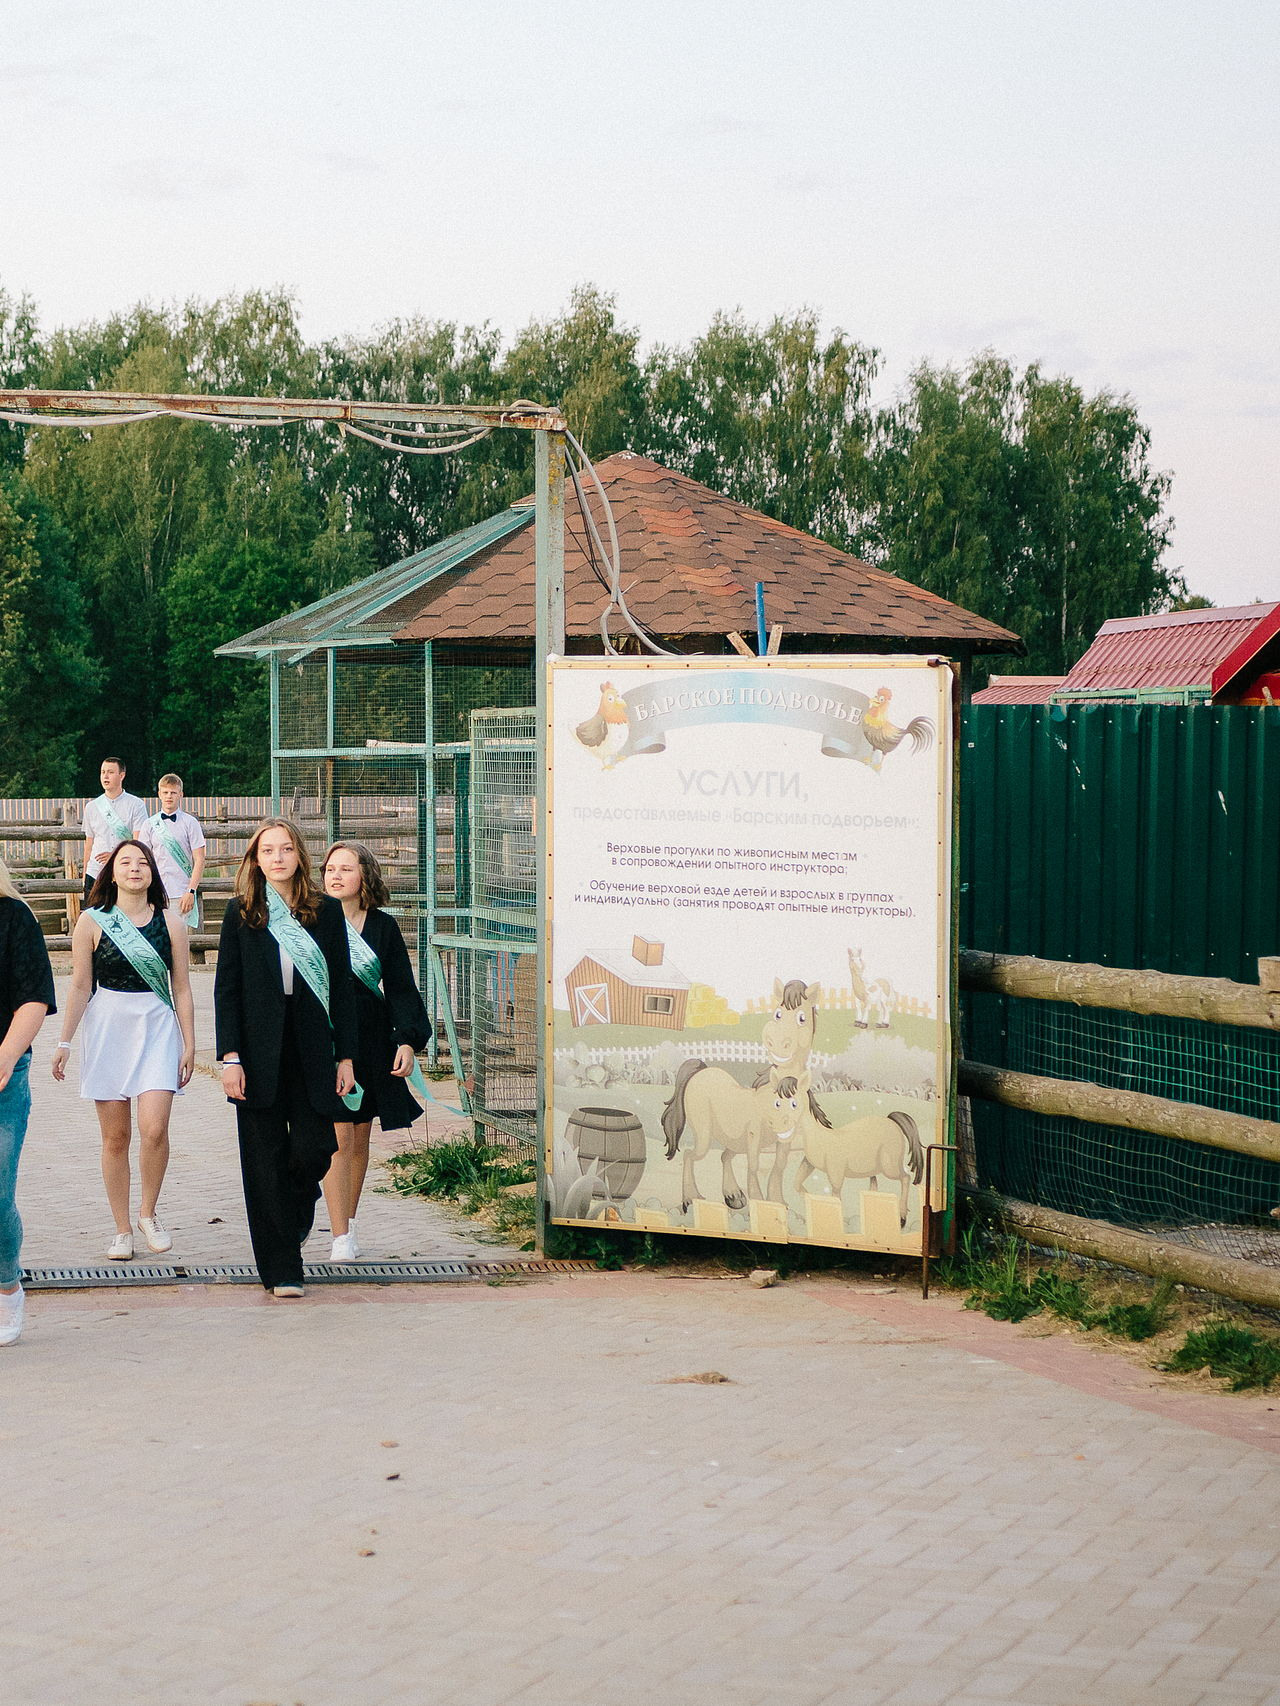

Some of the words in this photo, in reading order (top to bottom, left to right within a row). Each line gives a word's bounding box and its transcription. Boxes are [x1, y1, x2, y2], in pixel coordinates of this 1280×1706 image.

[633, 688, 738, 722] БАРСКОЕ
[739, 687, 863, 726] ПОДВОРЬЕ
[677, 769, 809, 802] УСЛУГИ,
[573, 806, 721, 822] предоставляемые
[607, 842, 661, 855] Верховые
[664, 844, 714, 858] прогулки
[717, 848, 730, 856] по
[734, 848, 809, 860] живописным
[612, 857, 617, 866] в
[620, 857, 712, 870] сопровождении
[714, 860, 767, 872] опытного
[770, 862, 848, 876] инструктора;
[590, 880, 645, 892] Обучение
[648, 884, 700, 896] верховой
[704, 886, 730, 896] езде
[733, 886, 768, 898] детей
[770, 889, 778, 898] и
[780, 890, 836, 902] взрослых
[838, 892, 844, 900] в
[846, 892, 895, 904] группах
[574, 894, 581, 902] и
[584, 894, 670, 907] индивидуально
[673, 897, 720, 909] (занятия
[722, 900, 776, 912] проводят
[778, 902, 828, 914] опытные
[831, 904, 916, 918] инструкторы).
